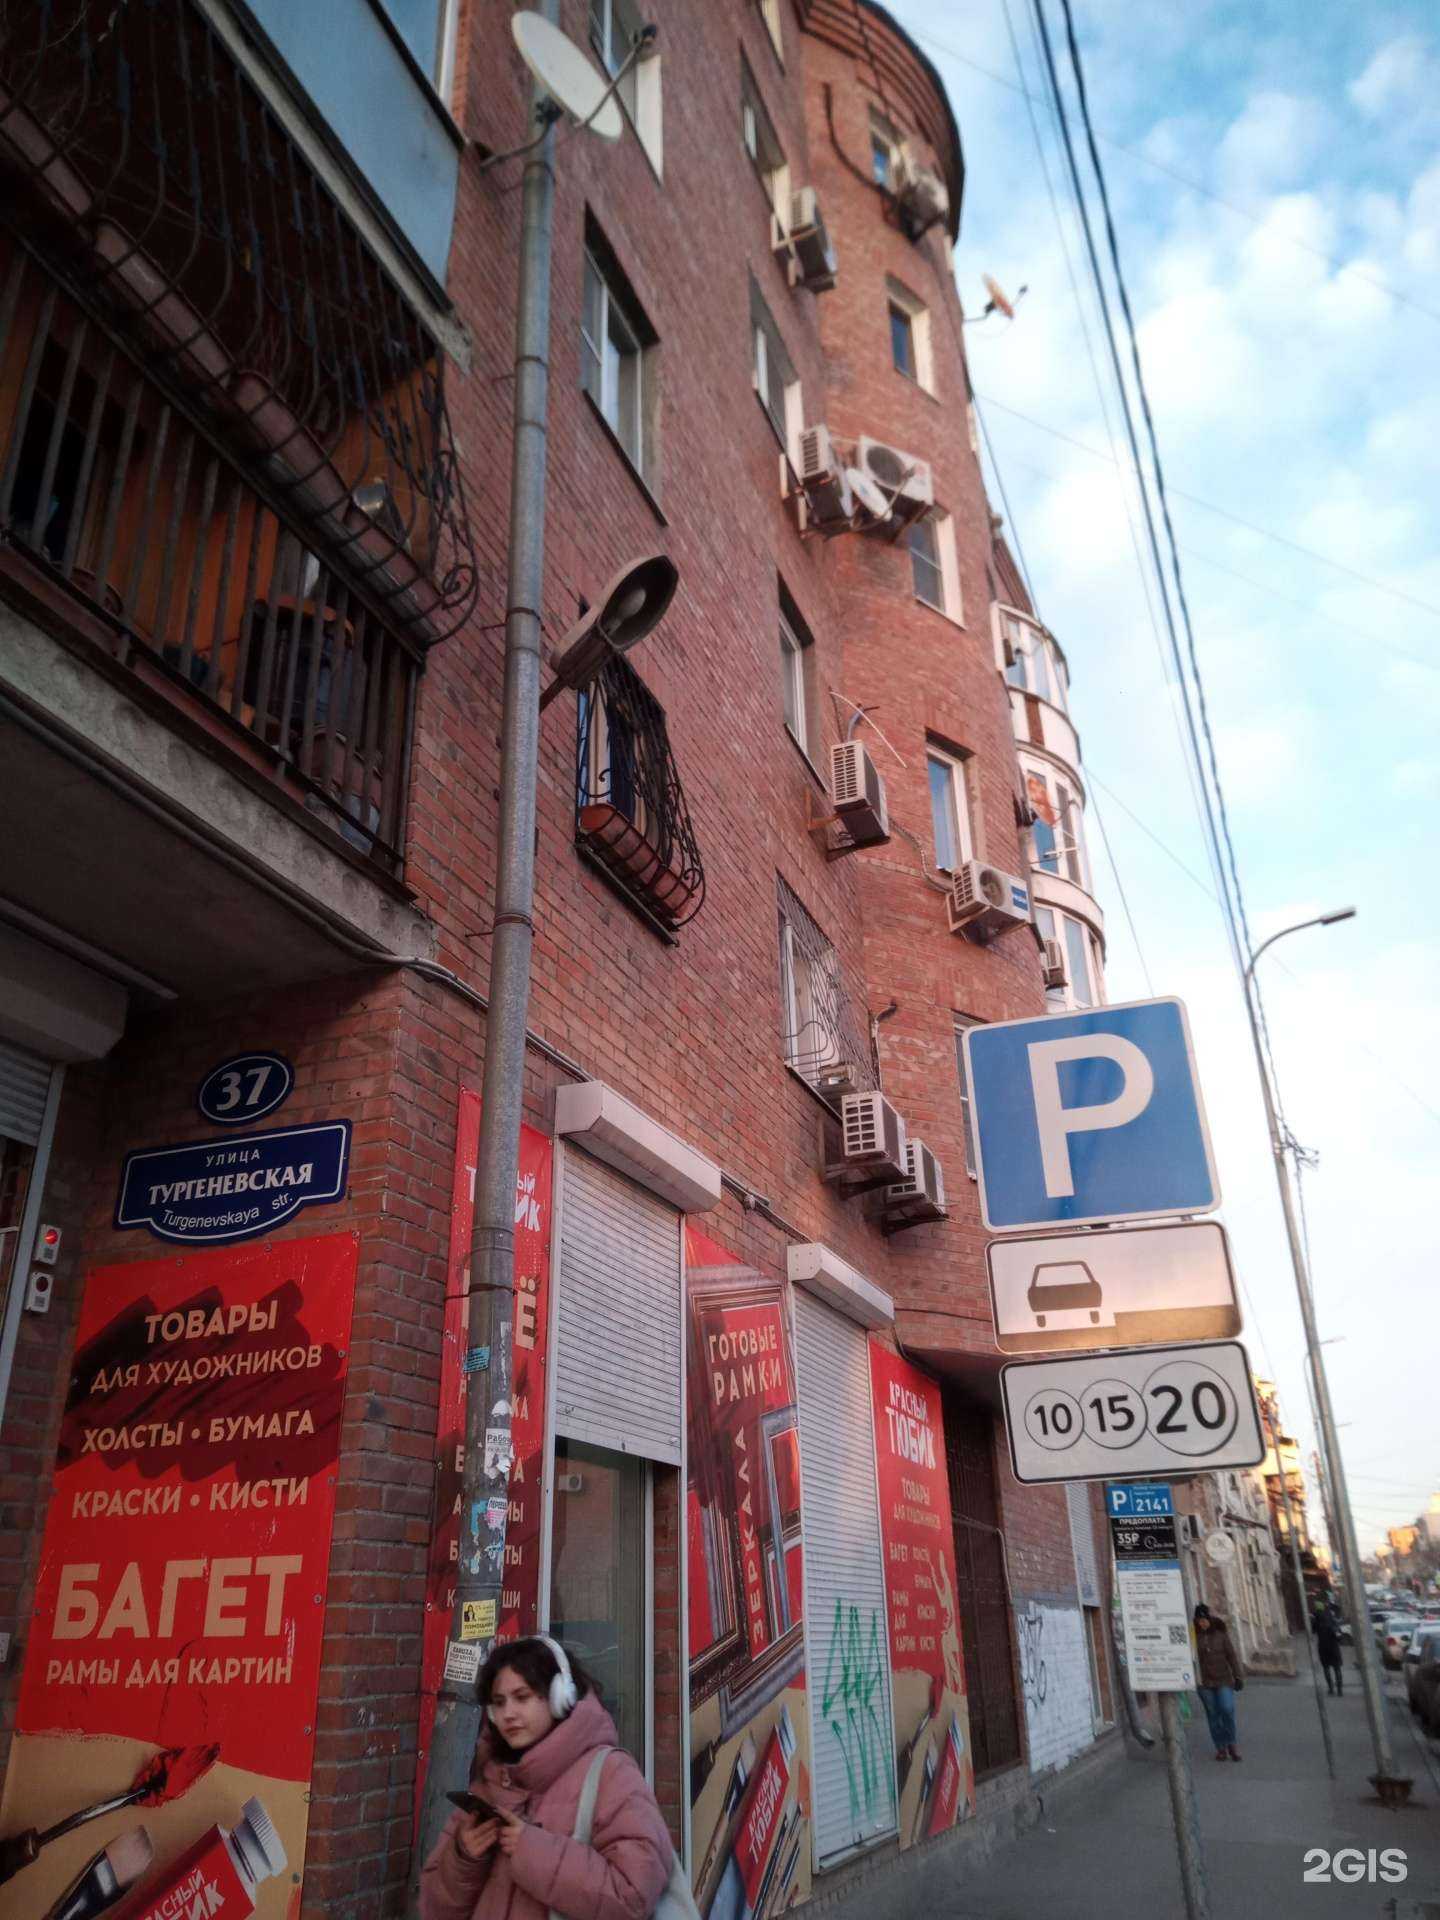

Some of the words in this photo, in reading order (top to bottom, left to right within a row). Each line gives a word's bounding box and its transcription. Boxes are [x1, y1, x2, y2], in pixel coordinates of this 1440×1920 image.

[215, 1066, 273, 1111] 37
[1026, 1032, 1154, 1199] P
[206, 1148, 260, 1168] УЛИЦА
[148, 1163, 314, 1206] ТУРГЕНЕВСКАЯ
[161, 1205, 260, 1230] Turgenevskaya
[271, 1190, 294, 1211] str.
[145, 1300, 279, 1344] ТОВАРЫ
[708, 1325, 778, 1364] ГОТОВЫЕ
[90, 1363, 139, 1394] ДЛЯ
[145, 1344, 322, 1387] ХУДОЖНИКОВ
[713, 1357, 783, 1406] РАМКИ
[889, 1380, 928, 1422] КРАСНЫЙ
[1033, 1403, 1073, 1436] 10
[1088, 1394, 1136, 1433] 15
[1149, 1380, 1227, 1435] 20
[81, 1421, 183, 1453] ХОЛСТЫ
[208, 1409, 316, 1444] БУМАГА
[884, 1406, 936, 1470] ТЮБИК
[72, 1484, 182, 1518] КРАСКИ
[209, 1476, 310, 1512] КИСТИ
[1111, 1490, 1127, 1512] P
[1136, 1498, 1169, 1512] 2141
[1119, 1517, 1166, 1526] ПРЕДОПЛАТА
[52, 1554, 303, 1641] БАГЕТ
[46, 1658, 119, 1686] РАМЫ
[125, 1657, 180, 1689] ДЛЯ
[187, 1656, 293, 1686] КАРТИН
